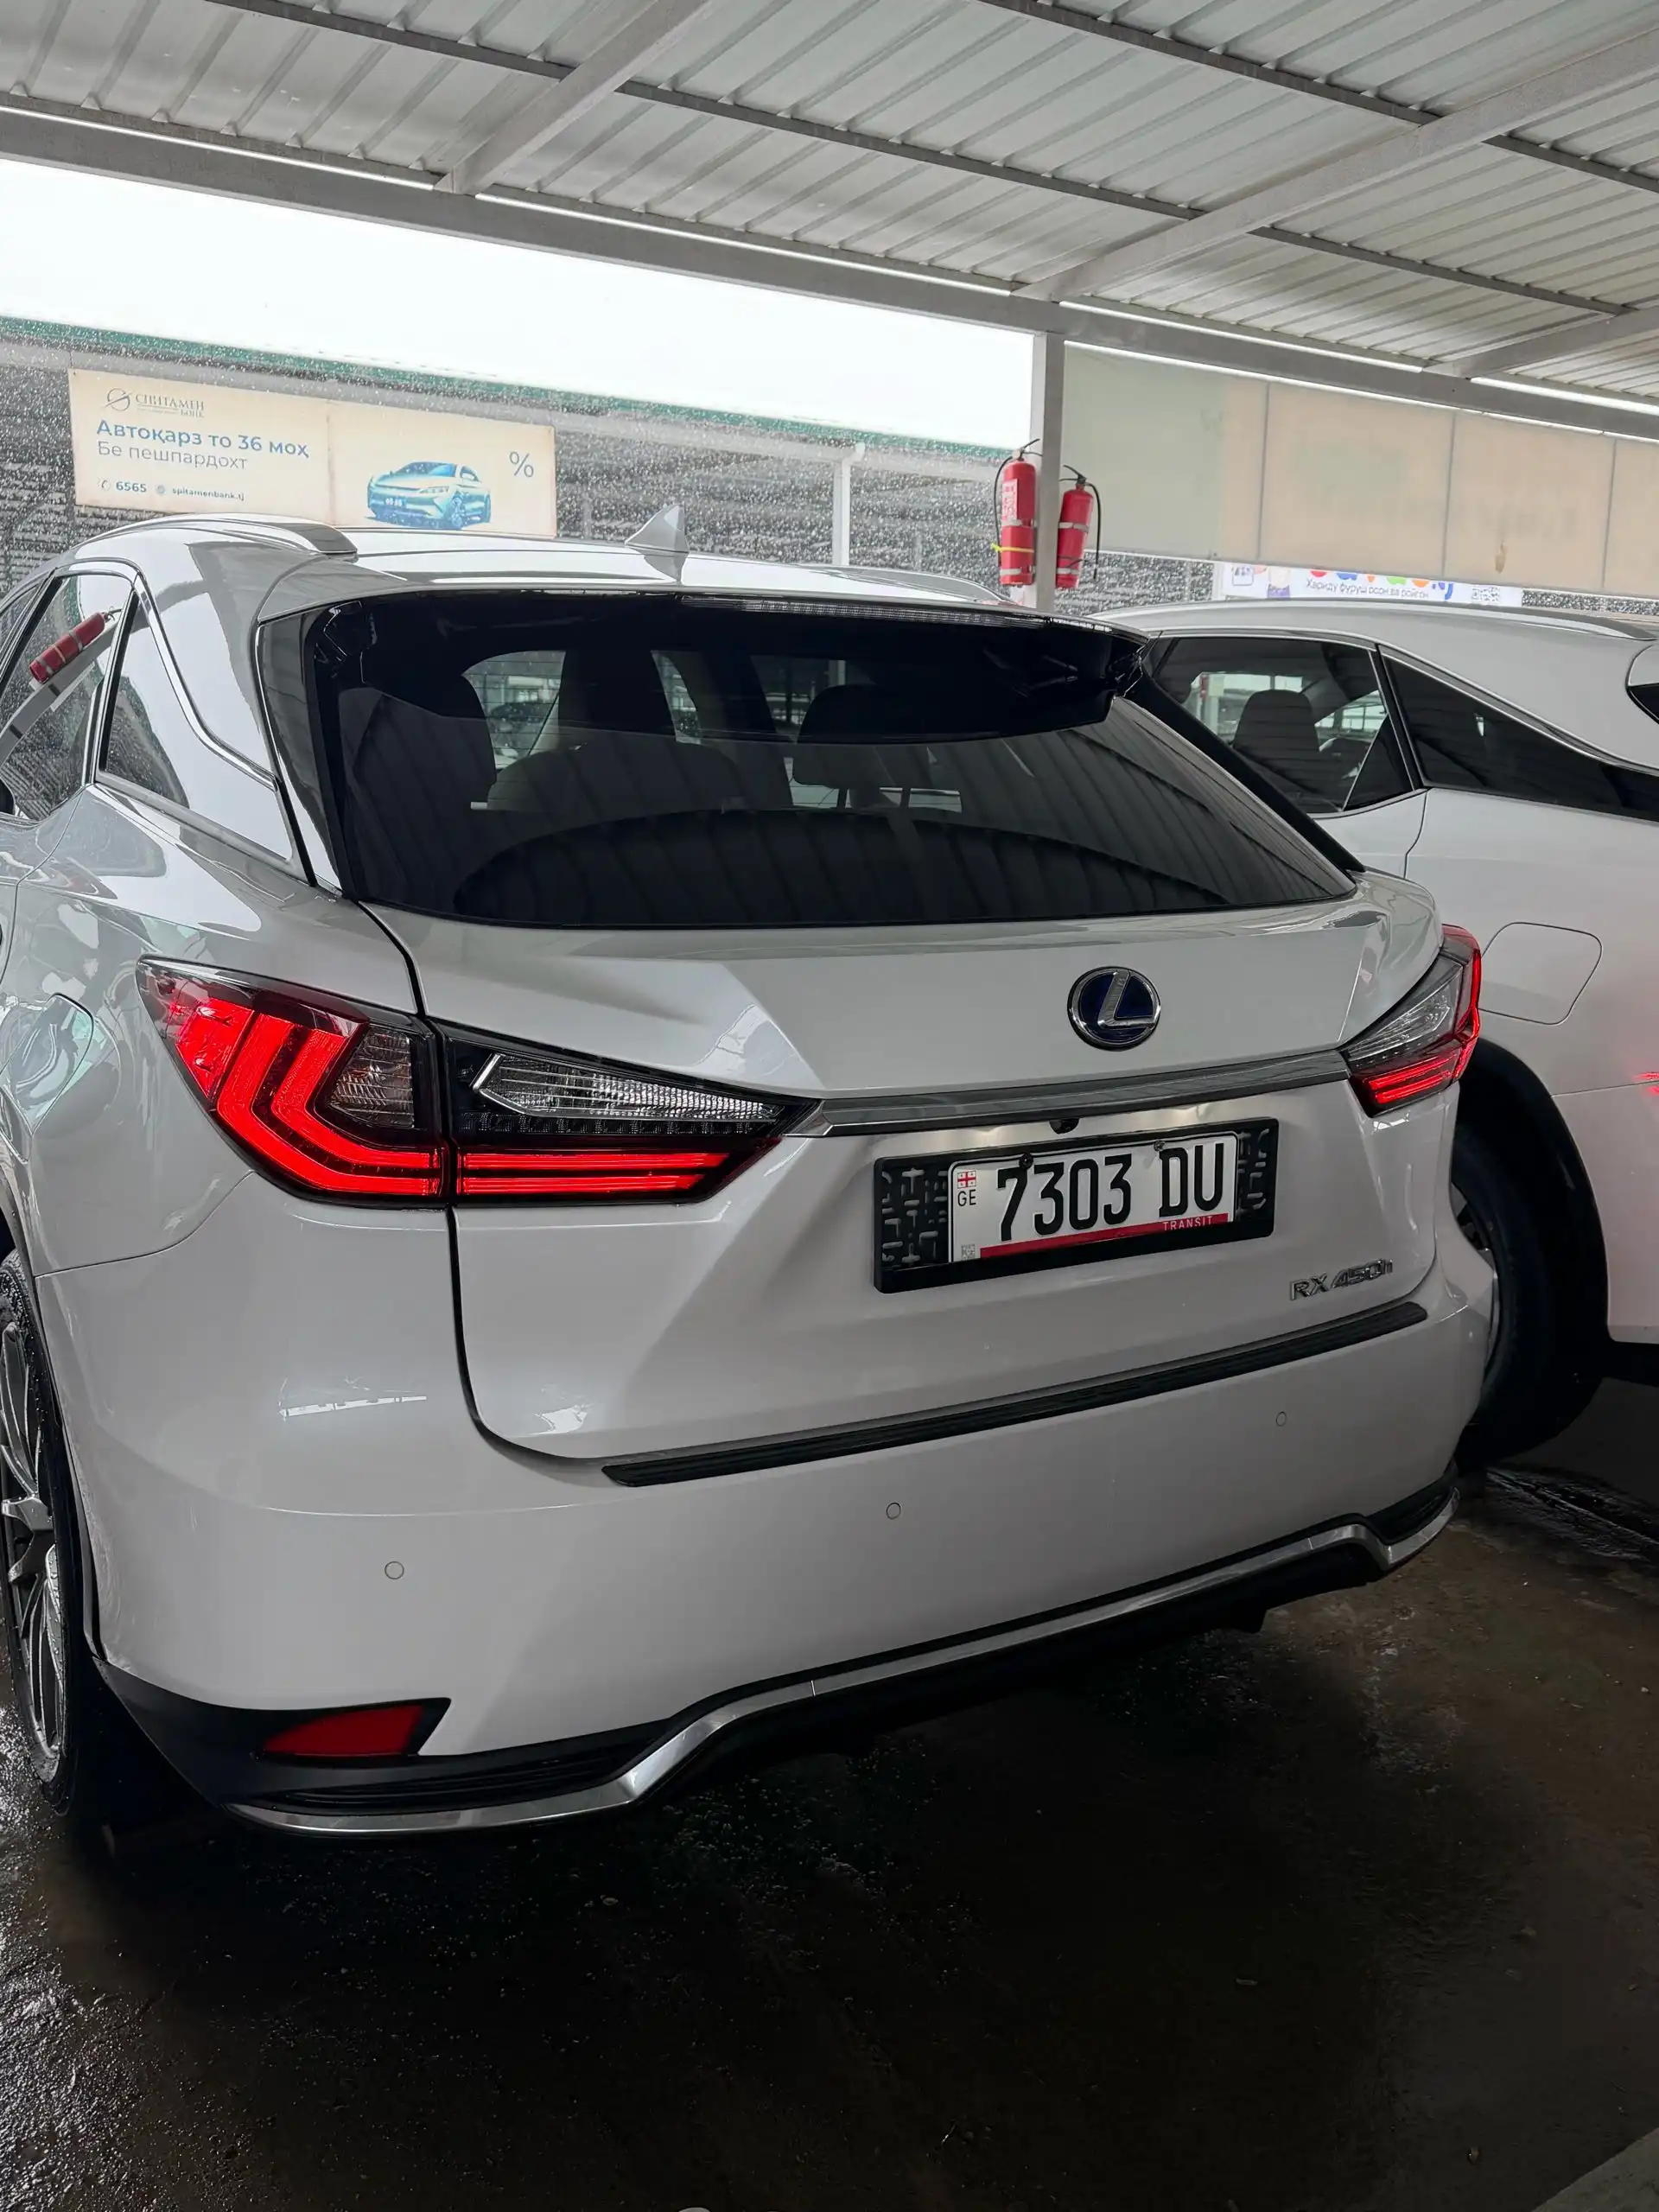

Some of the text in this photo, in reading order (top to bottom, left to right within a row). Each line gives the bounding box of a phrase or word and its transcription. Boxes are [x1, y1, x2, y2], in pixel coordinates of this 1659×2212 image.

[97, 419, 308, 458] Автоқарз то 36 моҳ
[98, 441, 248, 469] Бе пешпардохт
[509, 451, 534, 478] %
[116, 480, 147, 493] 6565
[172, 486, 245, 501] spitamenbank.tj
[957, 1189, 976, 1207] GE
[996, 1142, 1225, 1242] 7303 DU
[1162, 1216, 1213, 1231] TRANSIT
[1290, 1272, 1329, 1300] RX
